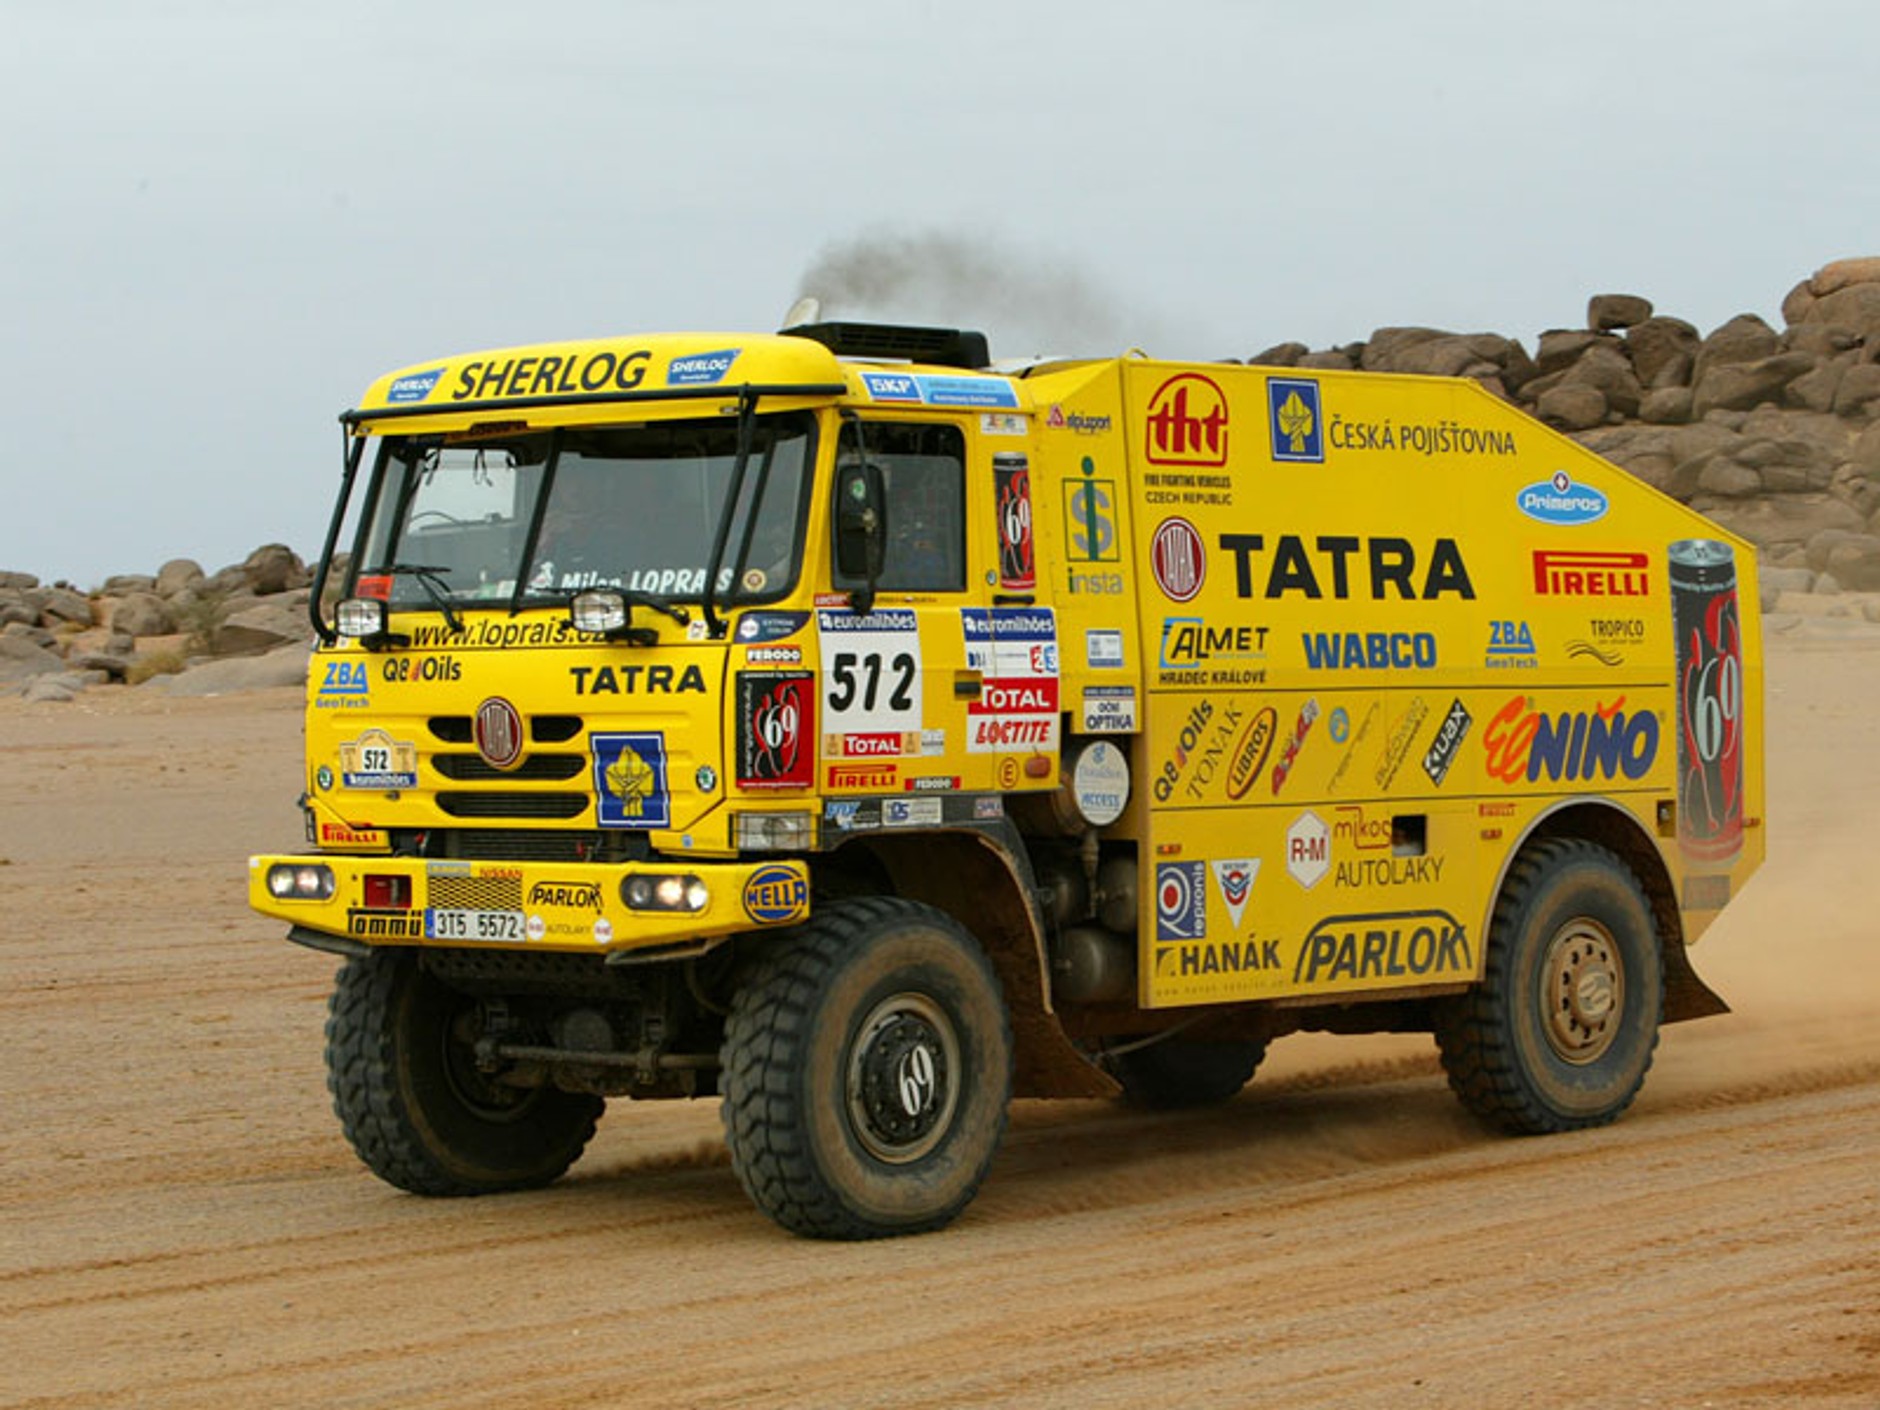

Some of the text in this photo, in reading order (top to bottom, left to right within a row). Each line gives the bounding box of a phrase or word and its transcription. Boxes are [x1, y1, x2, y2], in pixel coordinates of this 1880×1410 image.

[452, 351, 651, 400] SHERLOG
[671, 358, 728, 374] SHERLOG
[1329, 413, 1517, 455] ČESKÁ POJIŠŤOVNA
[1146, 491, 1232, 506] CZECH REPUBLIC
[1525, 493, 1601, 511] Primeros
[629, 568, 734, 593] LOPRAS
[1067, 567, 1123, 594] insta
[1219, 534, 1476, 601] TATRA
[1532, 550, 1649, 596] PIRELLI
[1487, 620, 1536, 653] ZBA
[1591, 620, 1644, 637] TROPICO
[747, 649, 801, 662] FERODO
[1171, 627, 1270, 659] ALMET
[1302, 632, 1437, 669] WABCO
[321, 662, 369, 693] ZBA
[570, 665, 707, 695] TATRA
[829, 652, 915, 712] 512
[1159, 671, 1209, 684] HRADEC
[981, 684, 1049, 708] TOTAL
[1694, 655, 1740, 762] 69
[764, 704, 797, 748] 69
[974, 721, 1052, 743] LOCTITE
[1086, 715, 1133, 729] OPTIKA
[844, 736, 900, 753] TOTAL
[1186, 700, 1242, 798] TONAK
[1232, 719, 1268, 786] LIBROS
[828, 764, 897, 788] PIRELLI
[1291, 838, 1325, 862] R-M
[480, 867, 522, 879] NISSAN
[1335, 857, 1444, 888] AUTOLAKY
[532, 886, 601, 908] PARLOK
[747, 881, 807, 907] HELLA
[436, 913, 518, 939] 3T5 5572
[1180, 932, 1282, 977] HANÁK
[1305, 925, 1467, 983] PARLOK
[900, 1045, 935, 1116] 69
